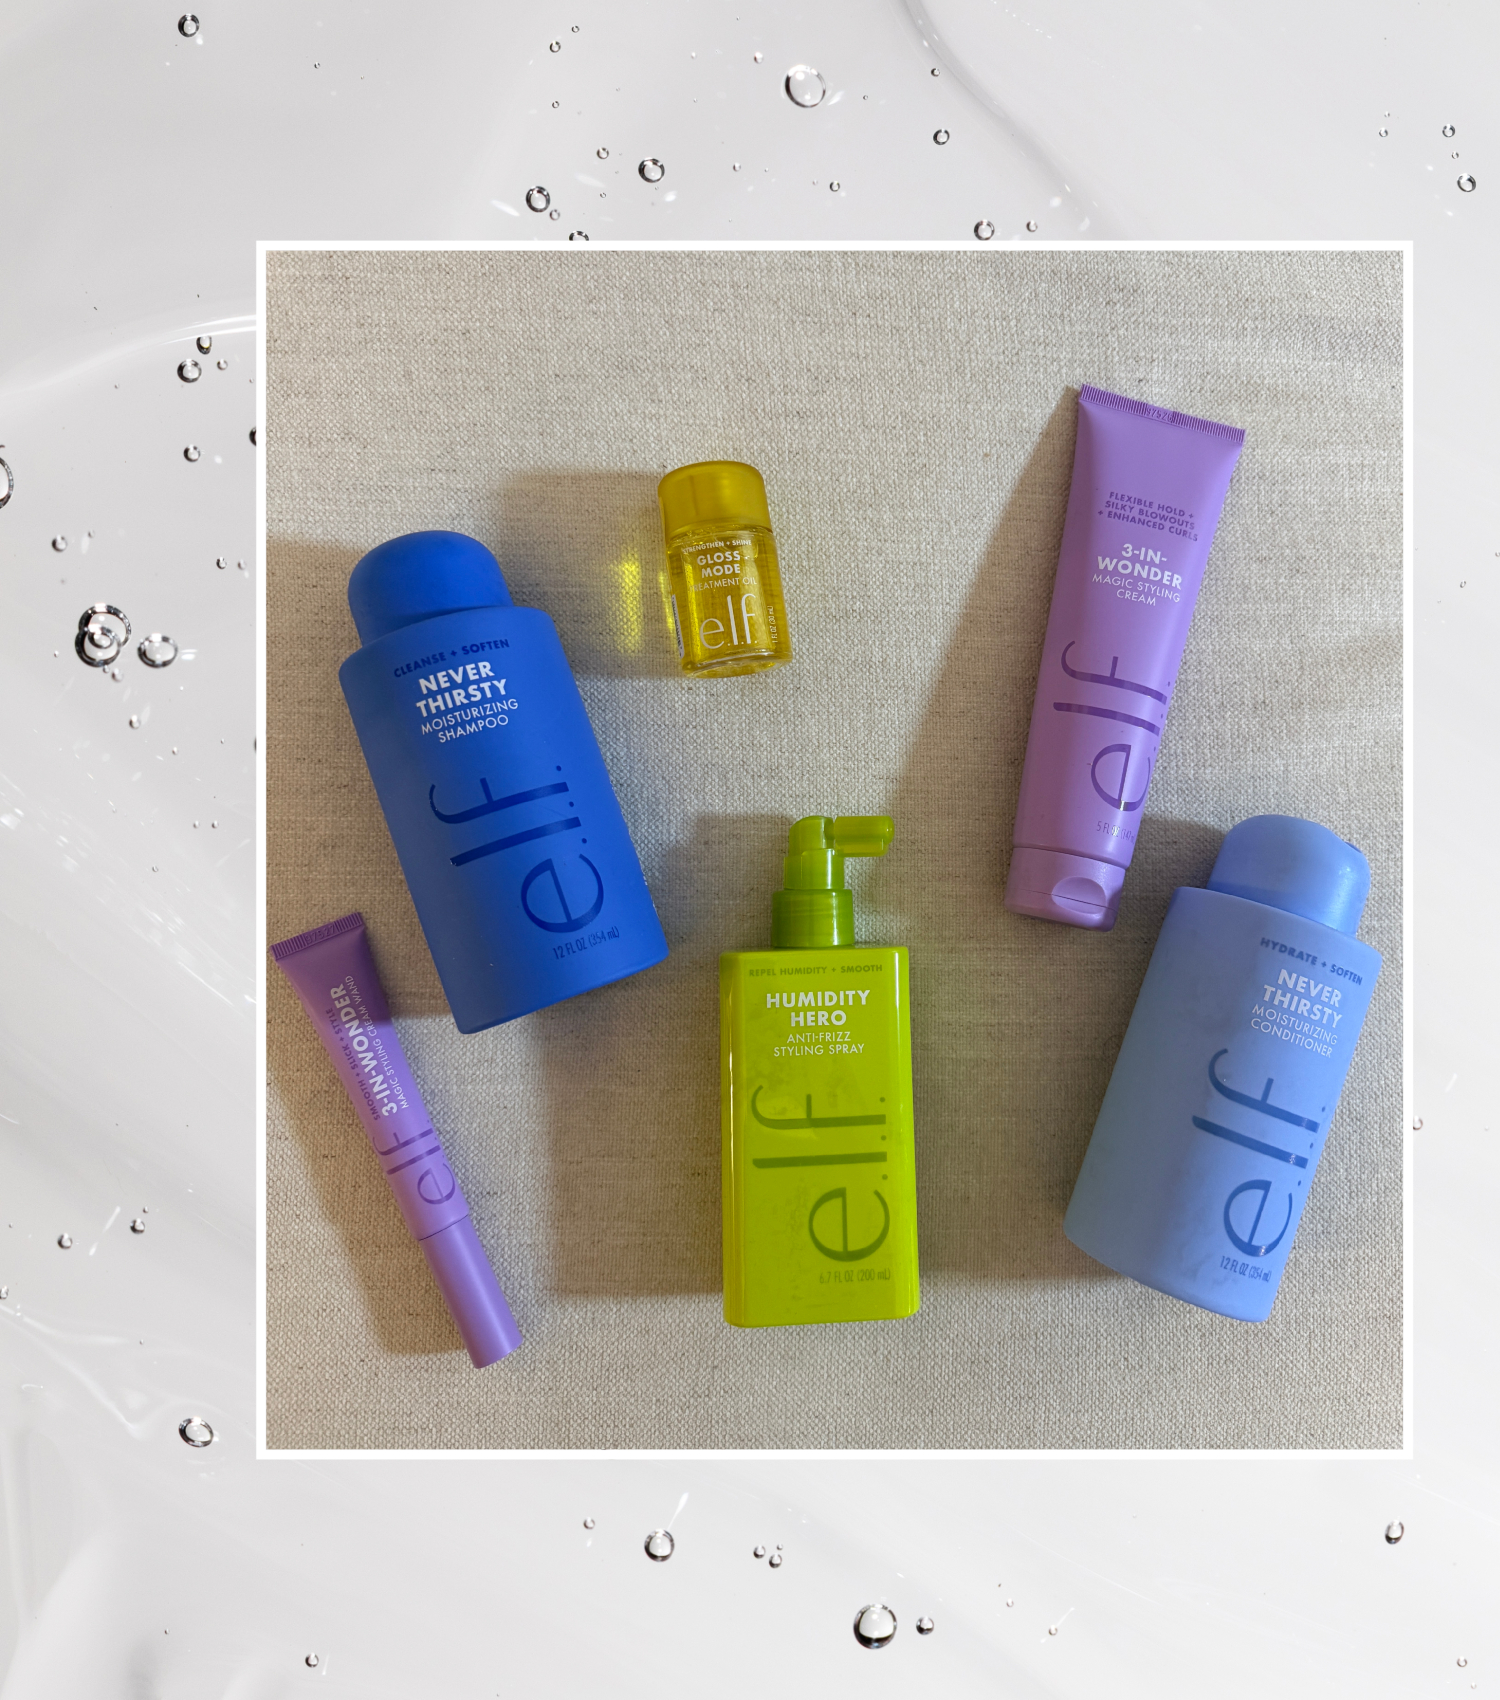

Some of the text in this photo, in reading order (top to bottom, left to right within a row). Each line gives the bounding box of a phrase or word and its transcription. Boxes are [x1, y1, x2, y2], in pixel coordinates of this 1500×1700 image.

[1104, 500, 1195, 531] SILKY BLOWOUTS
[1109, 491, 1154, 509] FLEXIBLE
[1157, 503, 1186, 517] HOLD
[1107, 510, 1165, 531] ENHANCED
[1168, 526, 1198, 542] CURLS
[682, 541, 725, 555] STRENGTHEN
[697, 550, 741, 566] GLOSS
[1121, 543, 1168, 565] 3-IN-
[701, 563, 741, 579] MODE
[742, 577, 757, 585] OIL
[1097, 556, 1183, 590] WONDER
[1092, 573, 1181, 603] MAGIC STYLING
[1116, 589, 1156, 606] CREAM
[393, 639, 510, 678] CLEANSE + SOFTEN
[418, 661, 495, 695] NEVER
[415, 679, 507, 718] THIRSTY
[421, 698, 518, 735] MOISTURIZING
[438, 714, 509, 743] SHAMPOO
[1096, 820, 1102, 832] 5
[1103, 822, 1110, 835] FL
[552, 945, 566, 960] 12
[565, 942, 576, 956] FL
[575, 937, 588, 952] OZ
[1260, 937, 1318, 966] HYDRATE
[1330, 964, 1363, 986] SOFTEN
[749, 968, 776, 977] REPEL
[780, 966, 827, 976] HUMIDITY
[840, 964, 883, 974] SMOOTH
[766, 989, 871, 1009] HUMIDITY
[1277, 968, 1342, 1008] NEVER
[790, 1010, 847, 1027] HERO
[1263, 984, 1343, 1029] THIRSTY
[325, 1007, 342, 1035] STYLE
[1251, 1004, 1338, 1046] MOISTURIZING
[330, 983, 398, 1117] 3-IN-WONDER
[345, 975, 410, 1109] MAGIC STYLING CREAM WAND
[773, 1043, 865, 1057] STYLING SPRAY
[787, 1031, 851, 1044] ANTI-FRIZZ
[1251, 1018, 1333, 1058] CONDITIONER
[342, 1043, 358, 1070] SLICK
[357, 1079, 381, 1120] SMOOTH
[819, 1271, 832, 1285] 6.7
[834, 1270, 843, 1283] FL
[844, 1269, 854, 1282] OZ
[856, 1268, 876, 1281] (200
[1219, 1255, 1231, 1270] 12
[1229, 1259, 1239, 1273] FL
[1239, 1262, 1250, 1276] OZ
